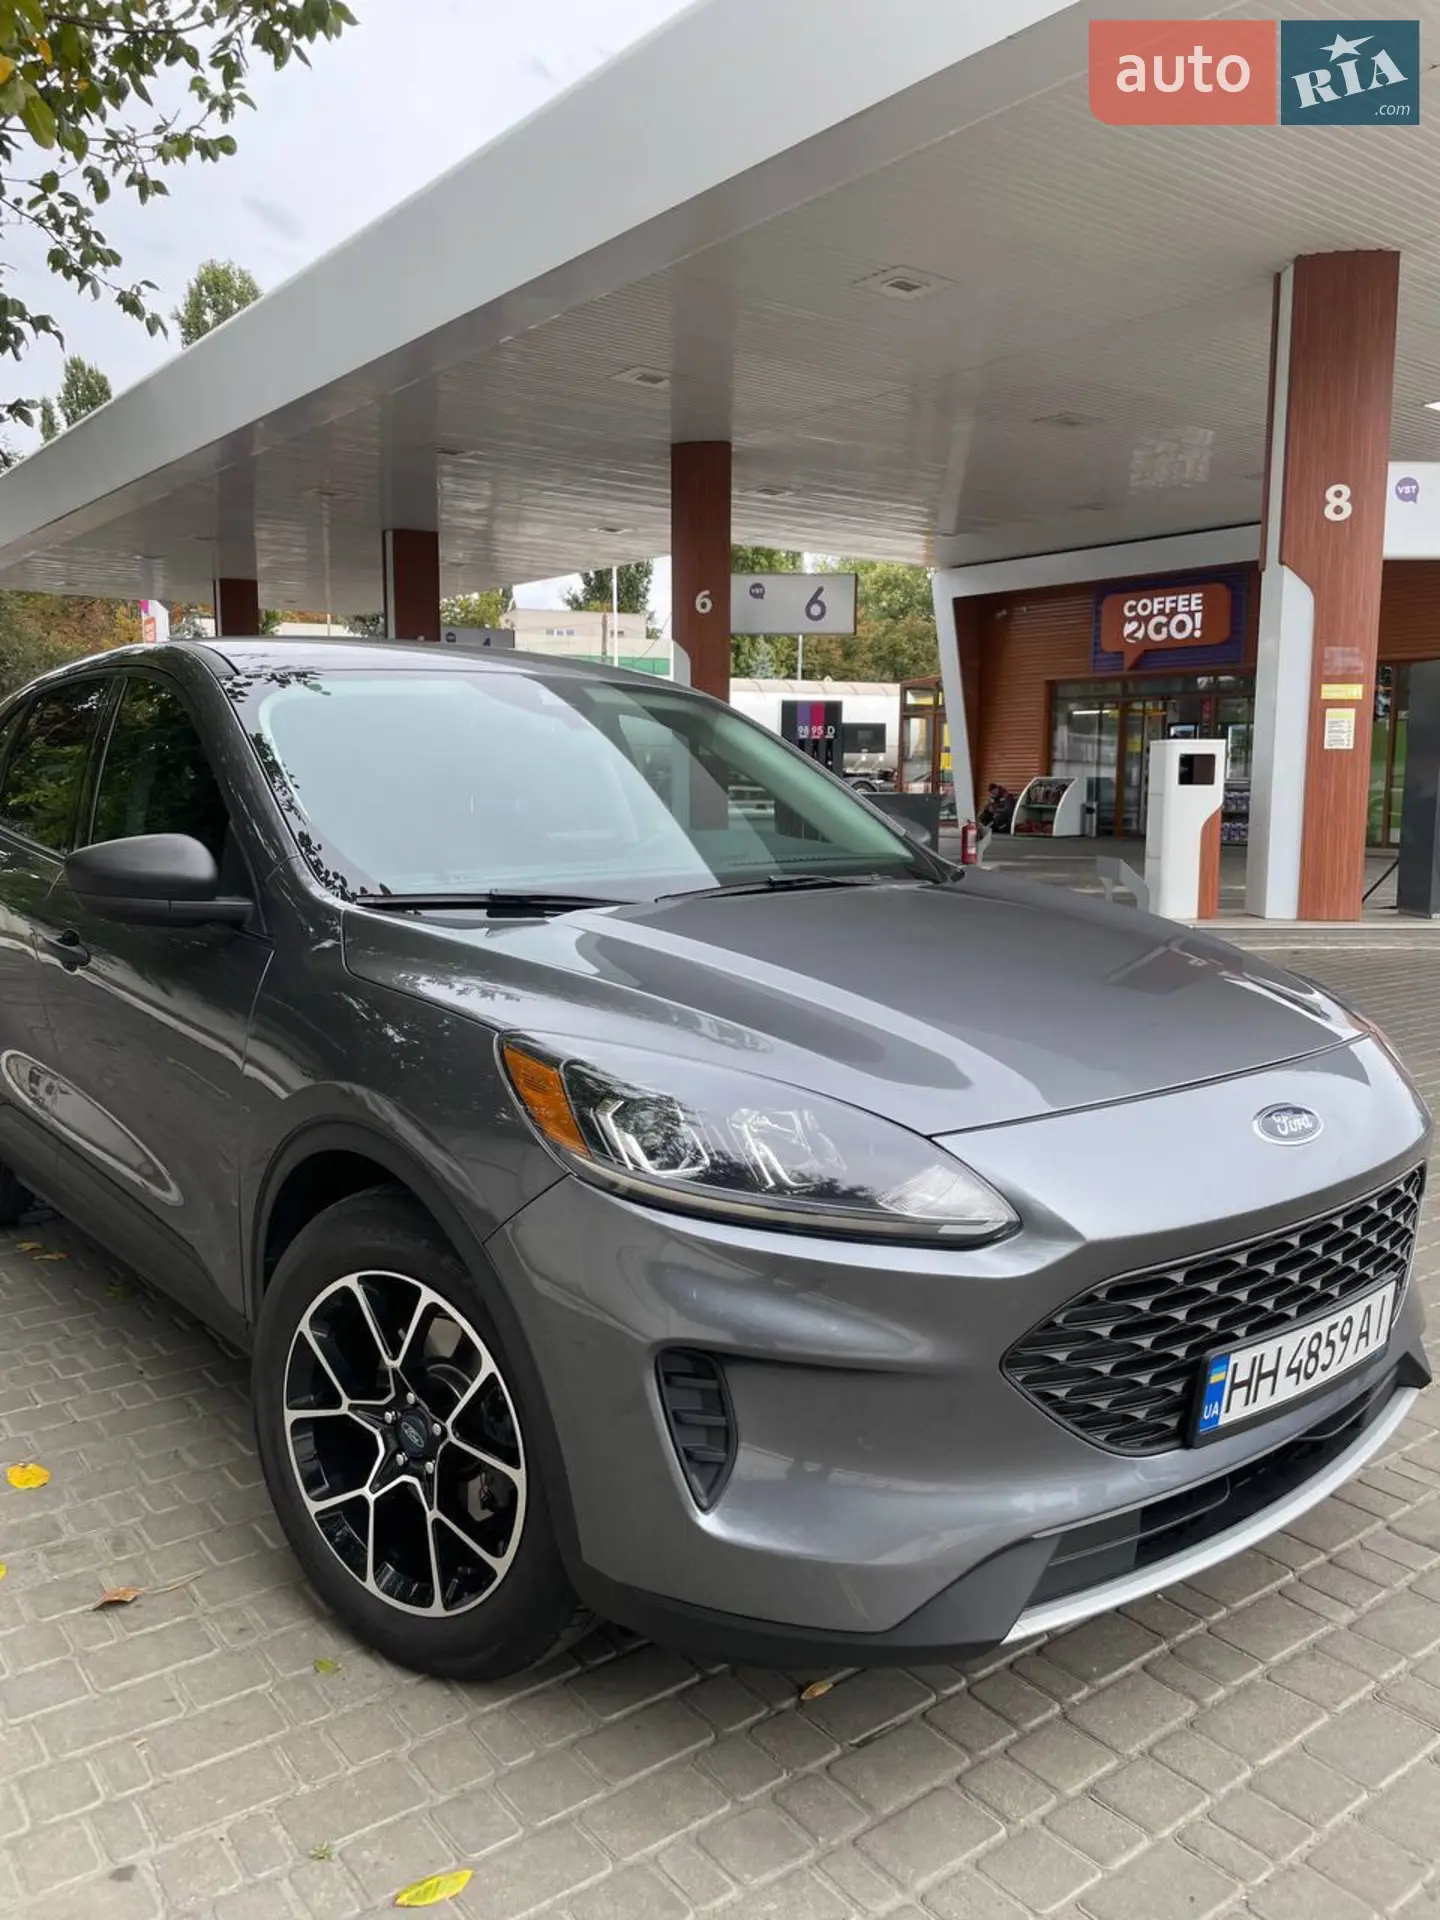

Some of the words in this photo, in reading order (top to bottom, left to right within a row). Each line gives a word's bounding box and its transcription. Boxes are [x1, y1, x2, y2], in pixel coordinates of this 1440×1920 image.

[1324, 483, 1352, 521] 8
[695, 589, 713, 614] 6
[805, 585, 827, 622] 6
[1123, 593, 1204, 617] COFFEE
[1271, 1109, 1313, 1136] Ford
[1203, 1404, 1219, 1420] UA
